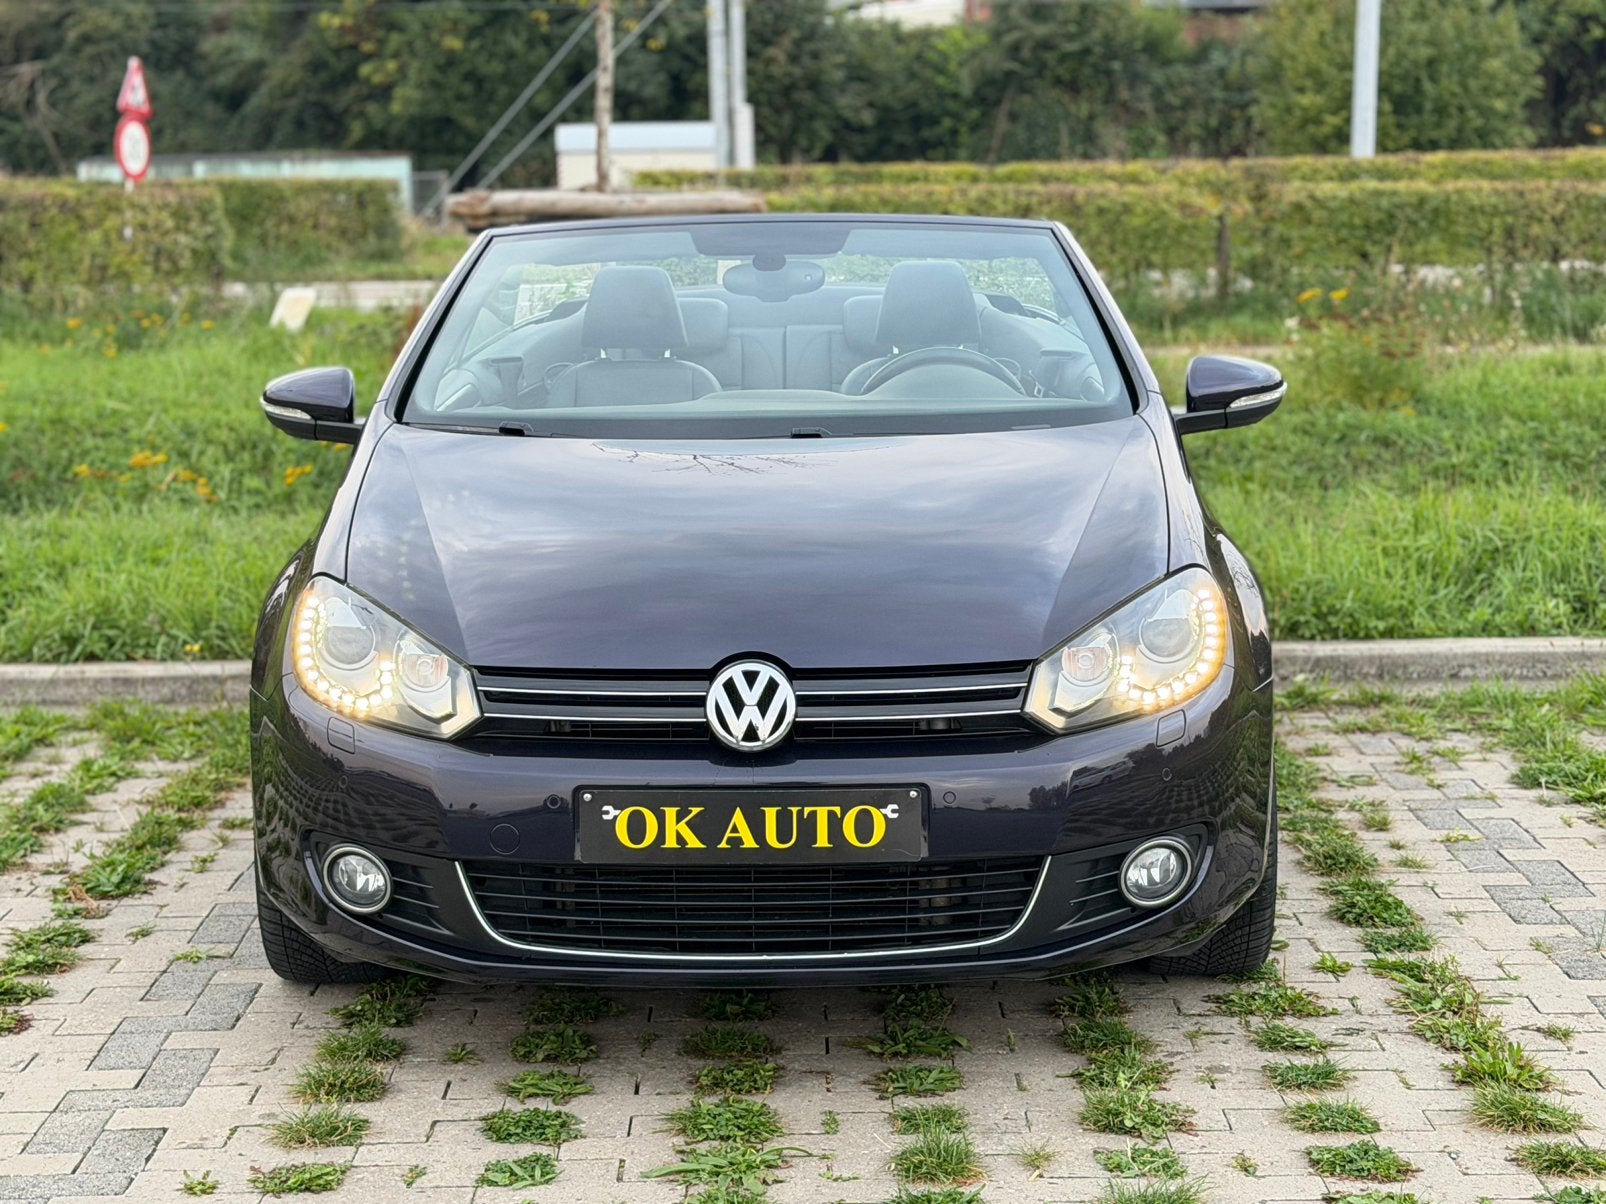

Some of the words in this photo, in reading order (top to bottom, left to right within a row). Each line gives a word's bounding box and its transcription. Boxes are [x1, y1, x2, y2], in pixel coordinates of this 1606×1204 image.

[707, 662, 796, 750] VW
[615, 806, 707, 849] OK
[717, 805, 886, 849] AUTO
